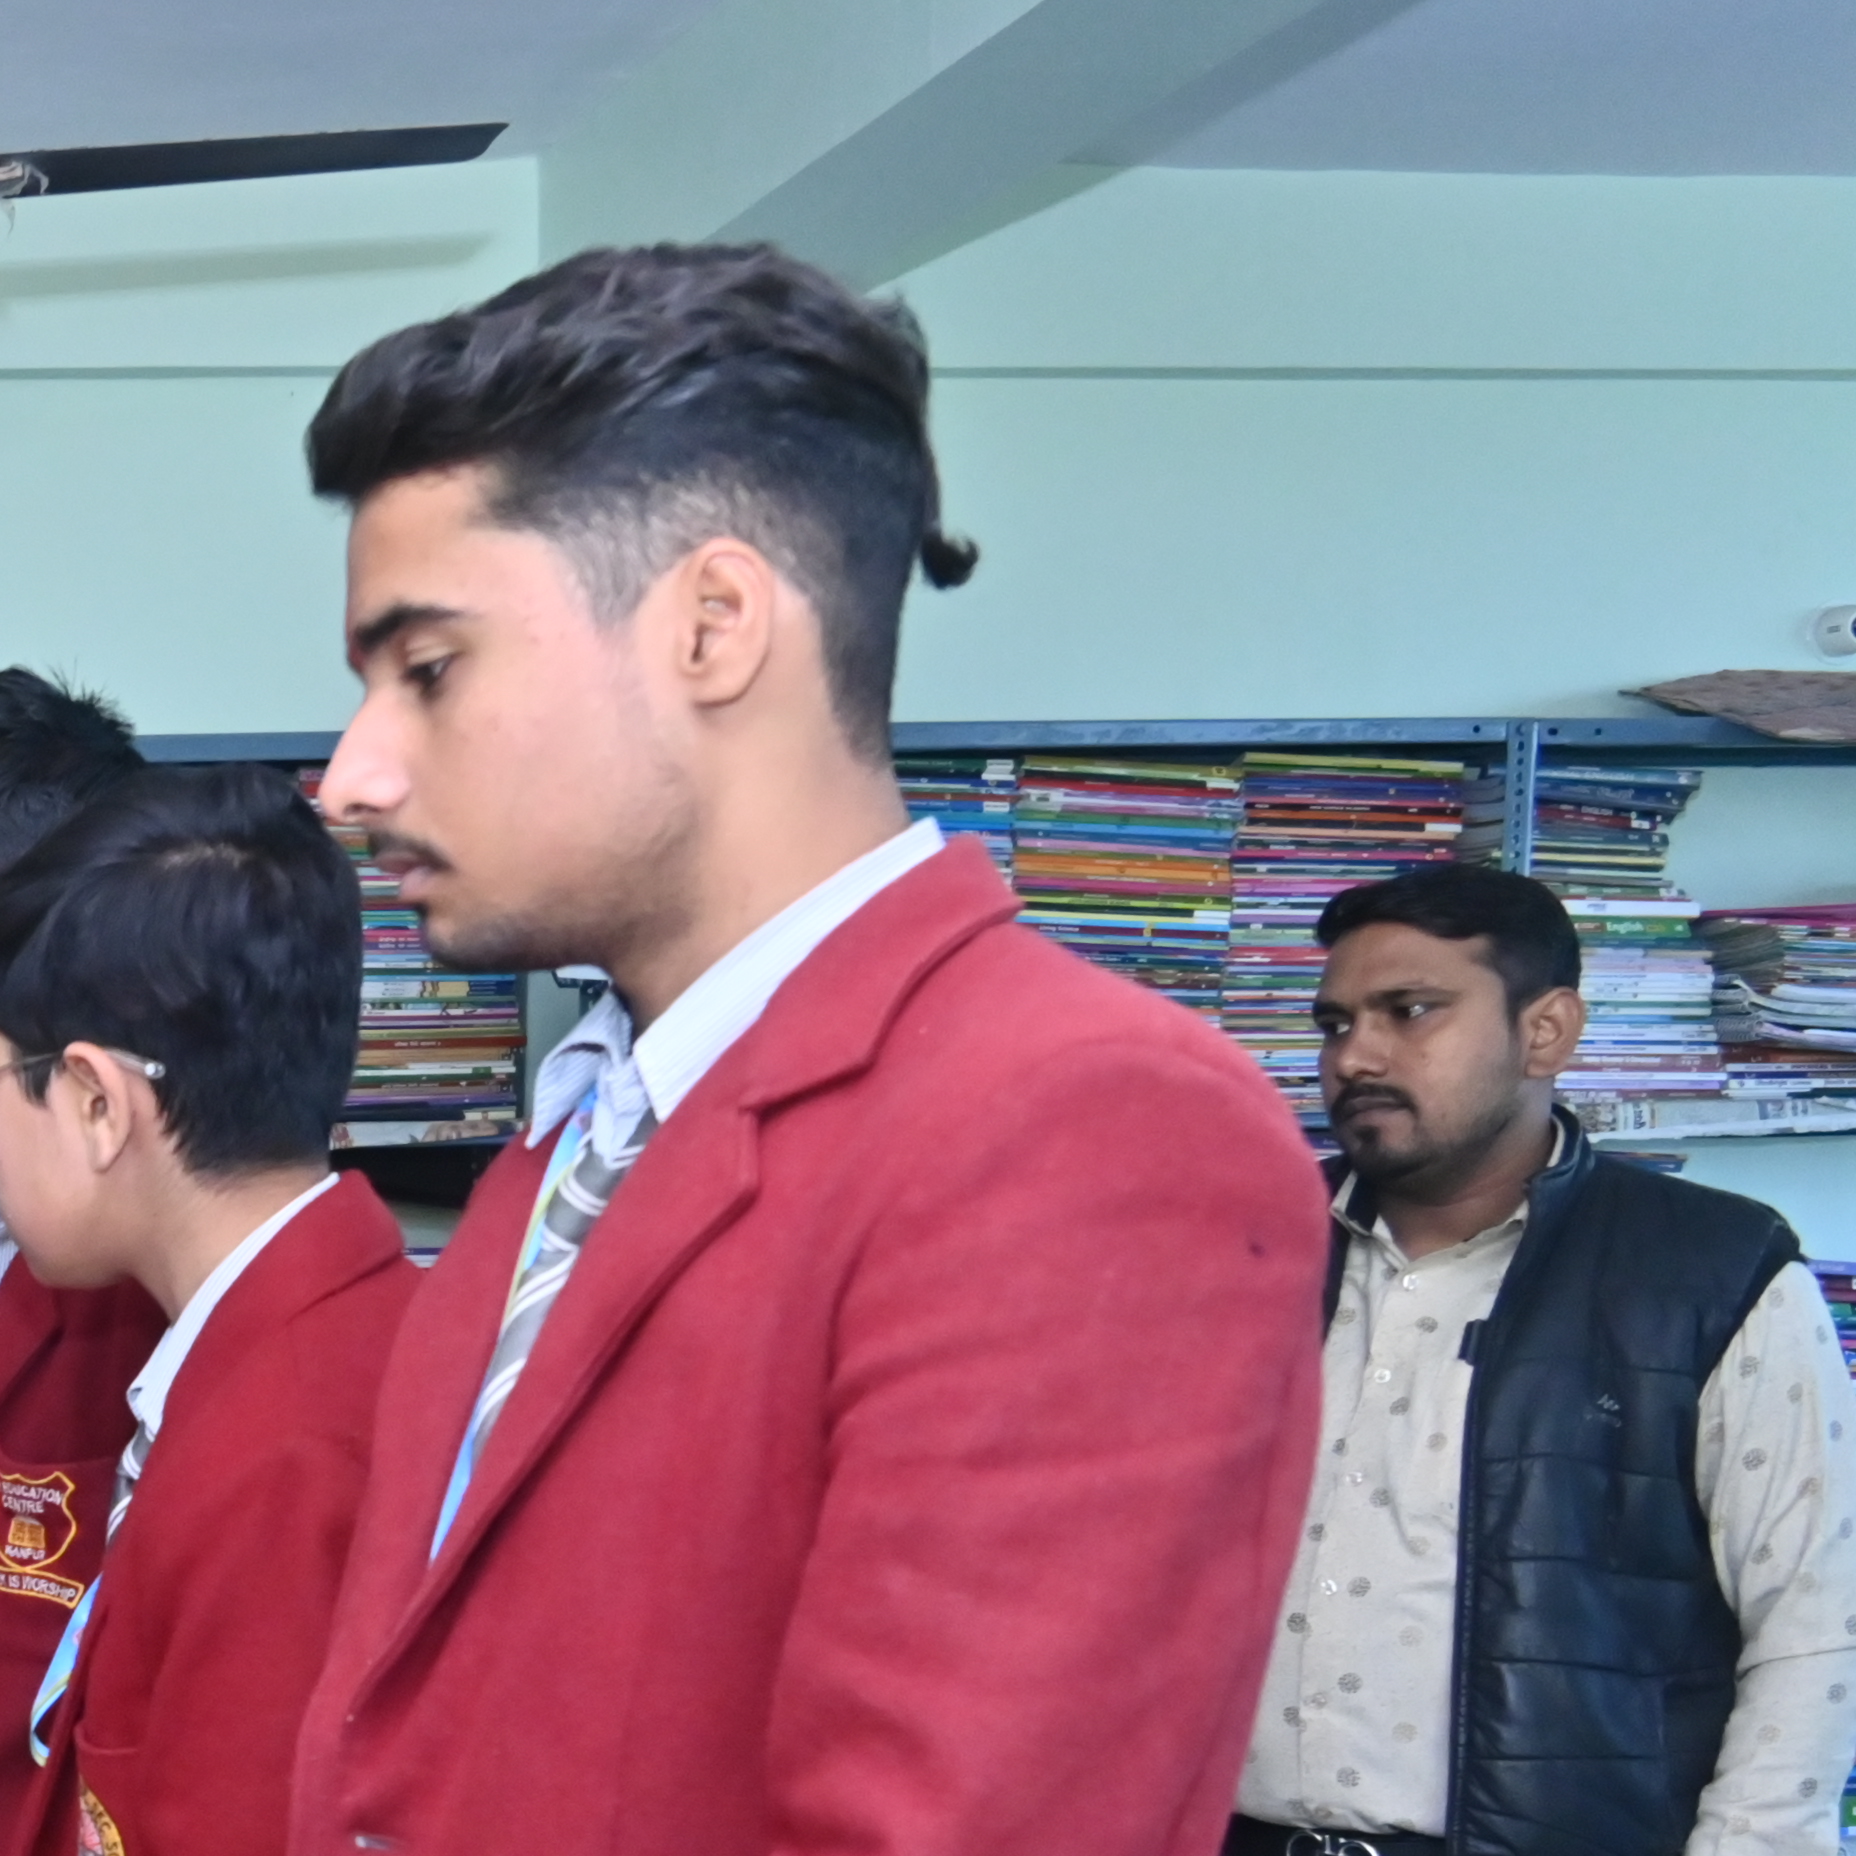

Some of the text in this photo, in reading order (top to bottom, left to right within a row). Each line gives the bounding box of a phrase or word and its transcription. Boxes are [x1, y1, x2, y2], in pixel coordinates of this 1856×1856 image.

[1, 1494, 45, 1513] CENTRE
[5, 1544, 46, 1560] KANPUR
[8, 1575, 20, 1588] IS
[22, 1575, 77, 1600] WORSHIP
